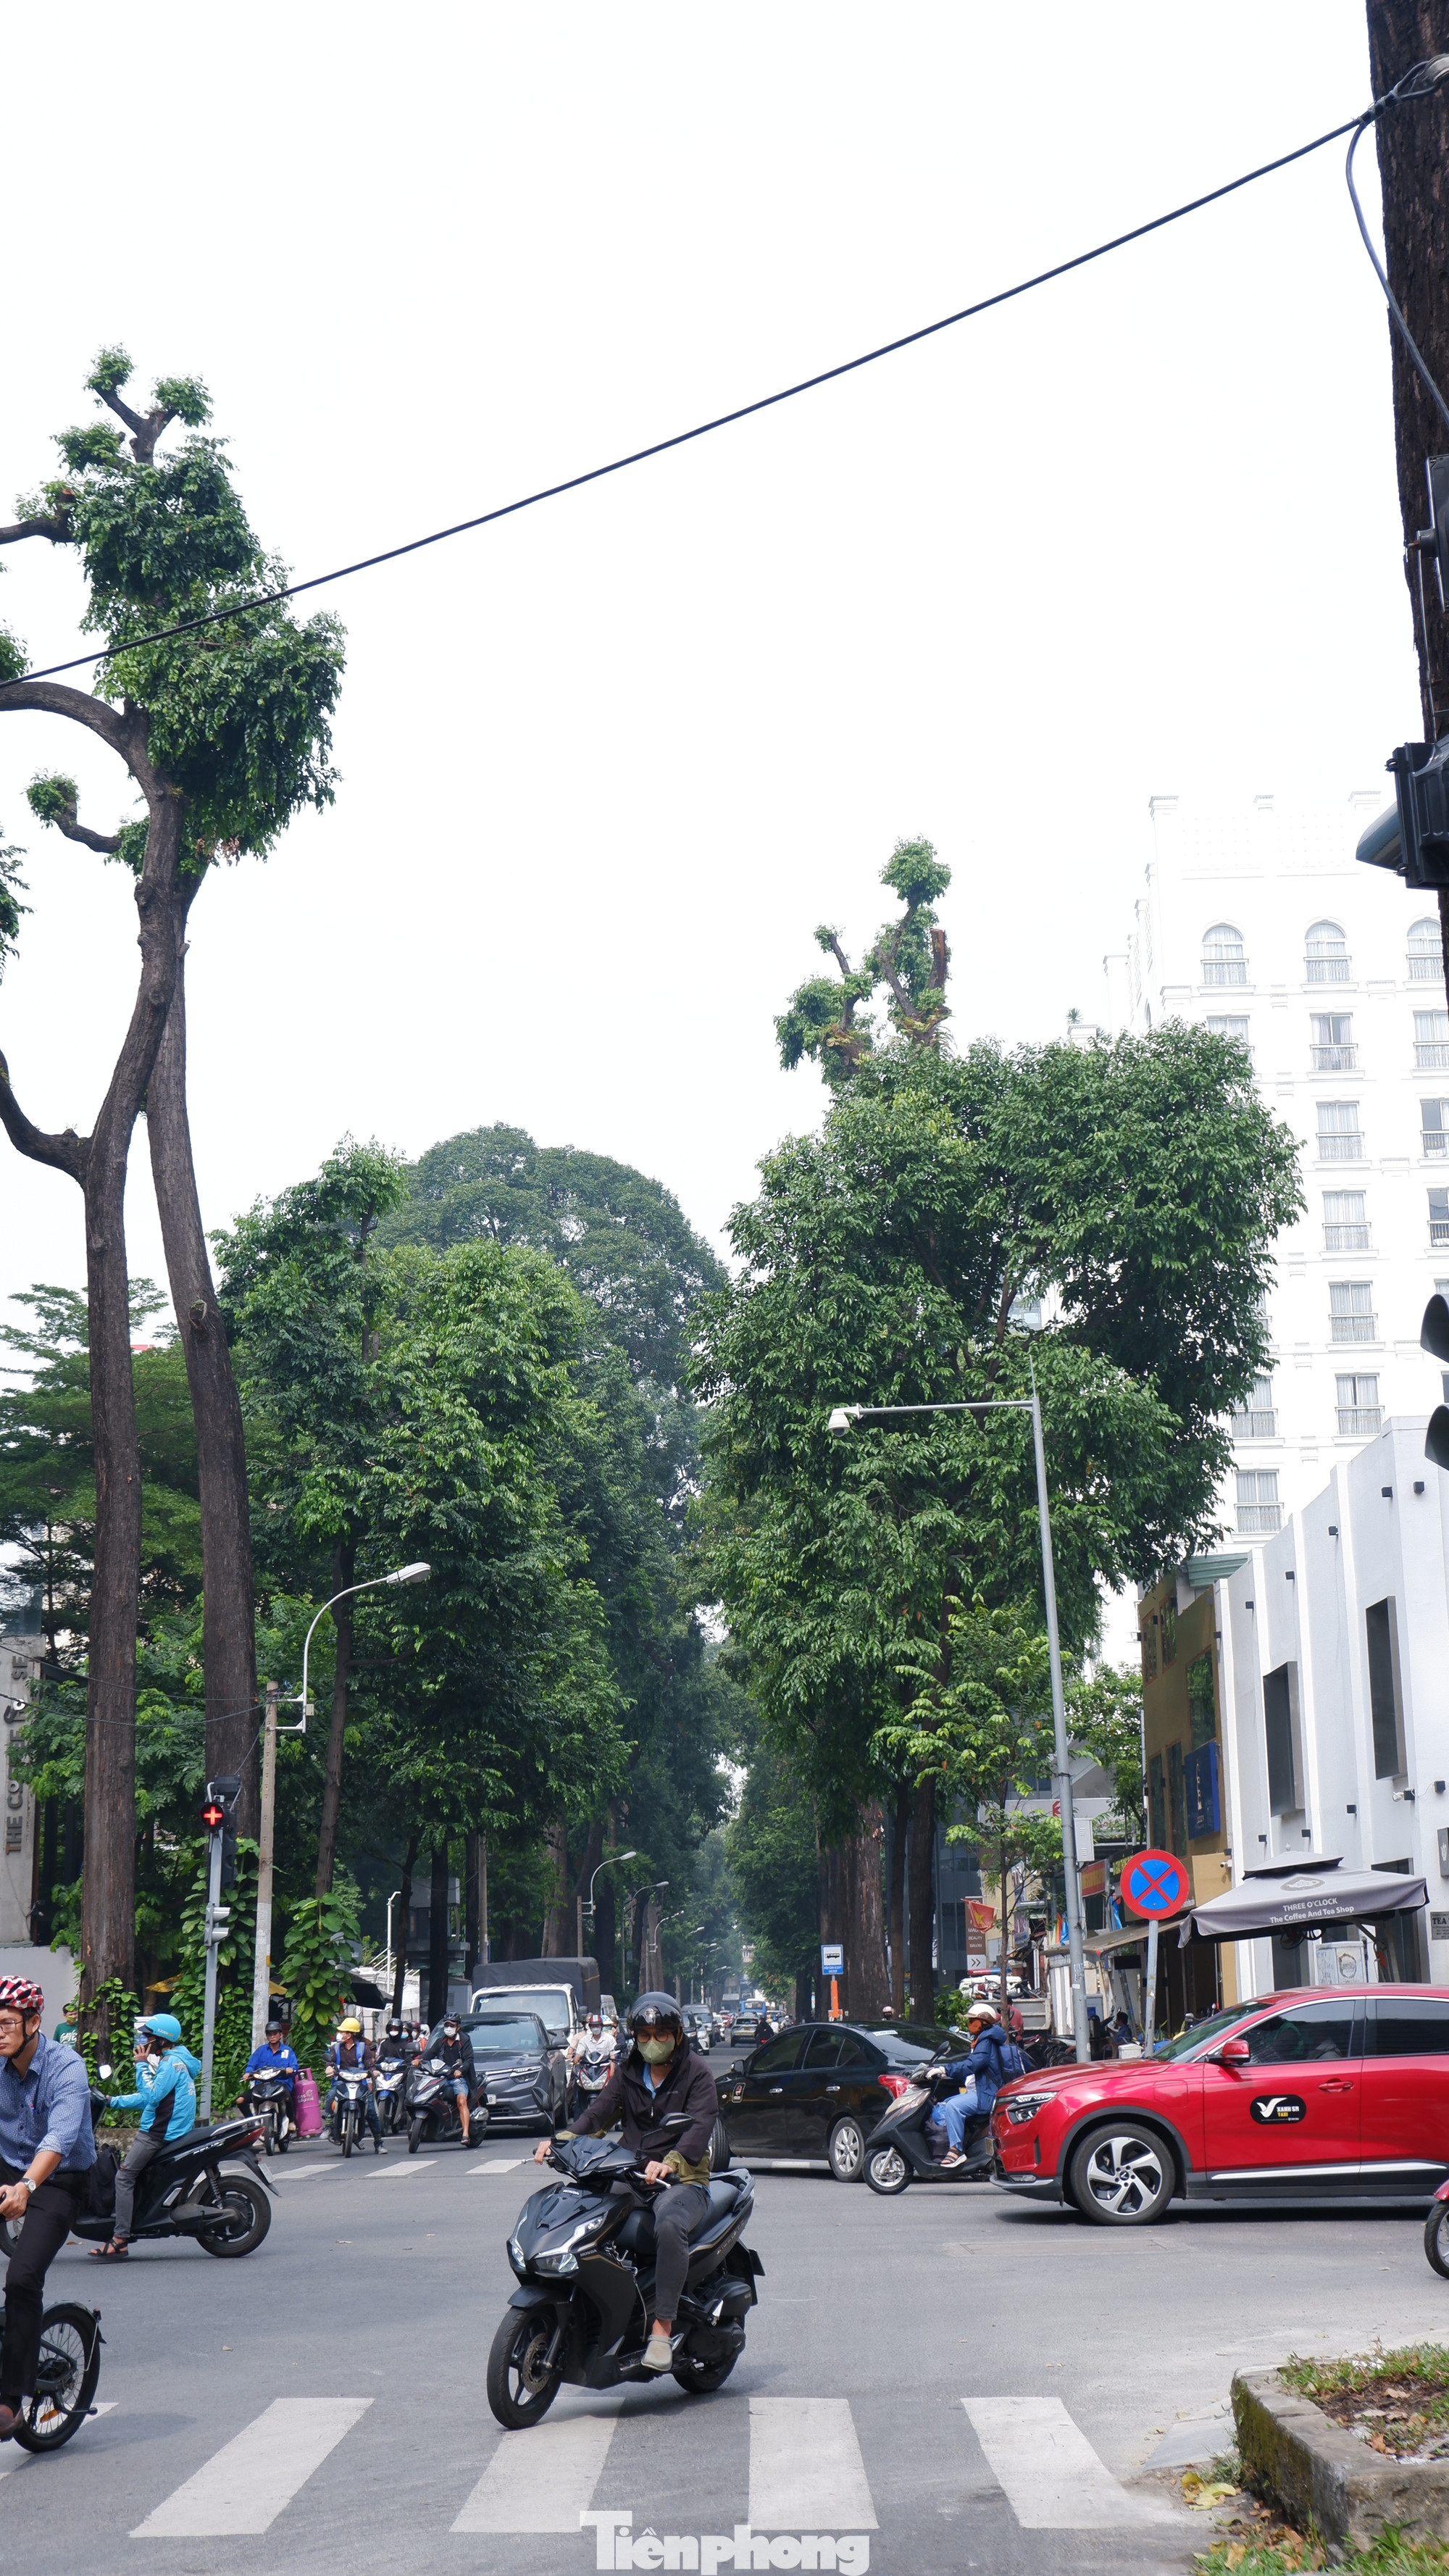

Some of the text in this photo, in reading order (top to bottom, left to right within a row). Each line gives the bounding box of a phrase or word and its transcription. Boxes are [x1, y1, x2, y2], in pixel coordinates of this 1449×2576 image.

[6, 1816, 22, 1854] THE
[1282, 1898, 1337, 1912] THREE O'CLOCK
[1284, 1912, 1306, 1922] Coffee
[1308, 1909, 1322, 1918] And
